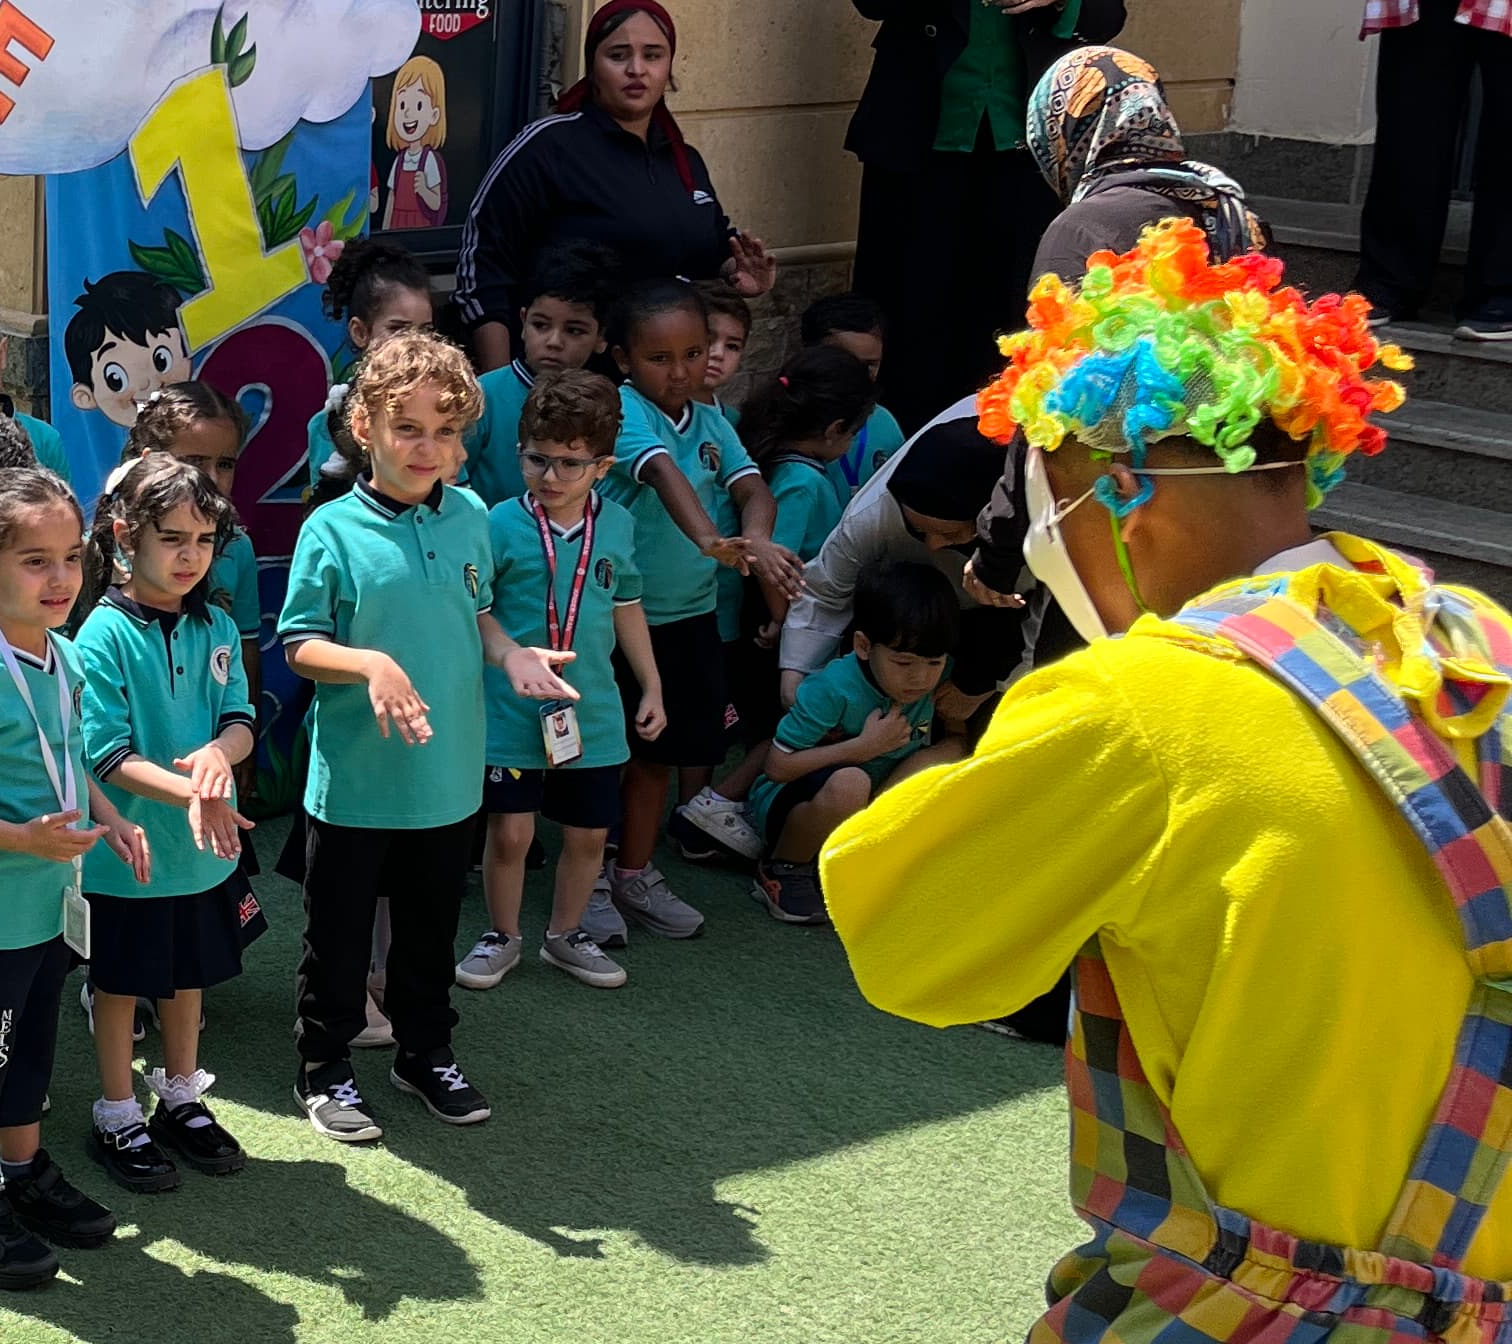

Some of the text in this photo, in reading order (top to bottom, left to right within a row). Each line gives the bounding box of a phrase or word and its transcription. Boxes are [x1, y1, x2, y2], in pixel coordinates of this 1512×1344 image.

[429, 14, 461, 33] FOOD
[129, 64, 309, 356] 1
[191, 317, 333, 561] 2
